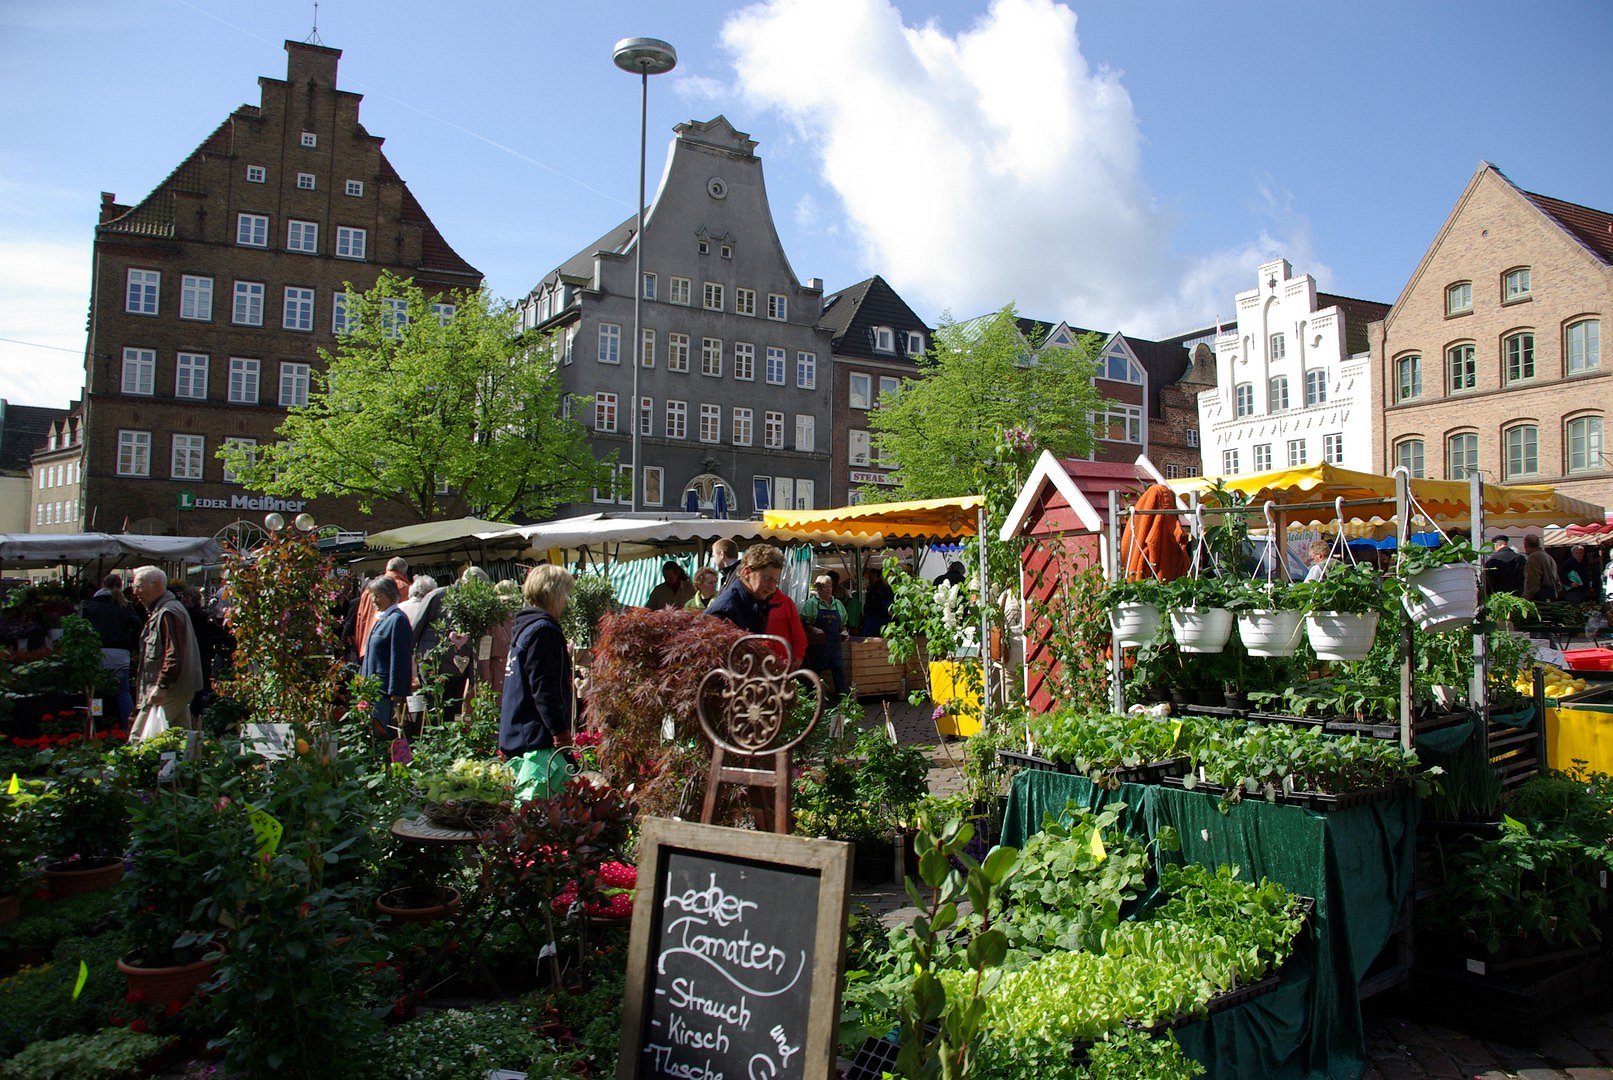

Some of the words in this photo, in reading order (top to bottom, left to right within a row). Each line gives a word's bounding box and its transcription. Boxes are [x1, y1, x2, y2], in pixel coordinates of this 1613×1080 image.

[231, 494, 307, 512] Meißner
[667, 916, 786, 975] Tomaten
[669, 978, 751, 1031] Strauch
[668, 1012, 729, 1053] Kirsch
[769, 1024, 800, 1069] und
